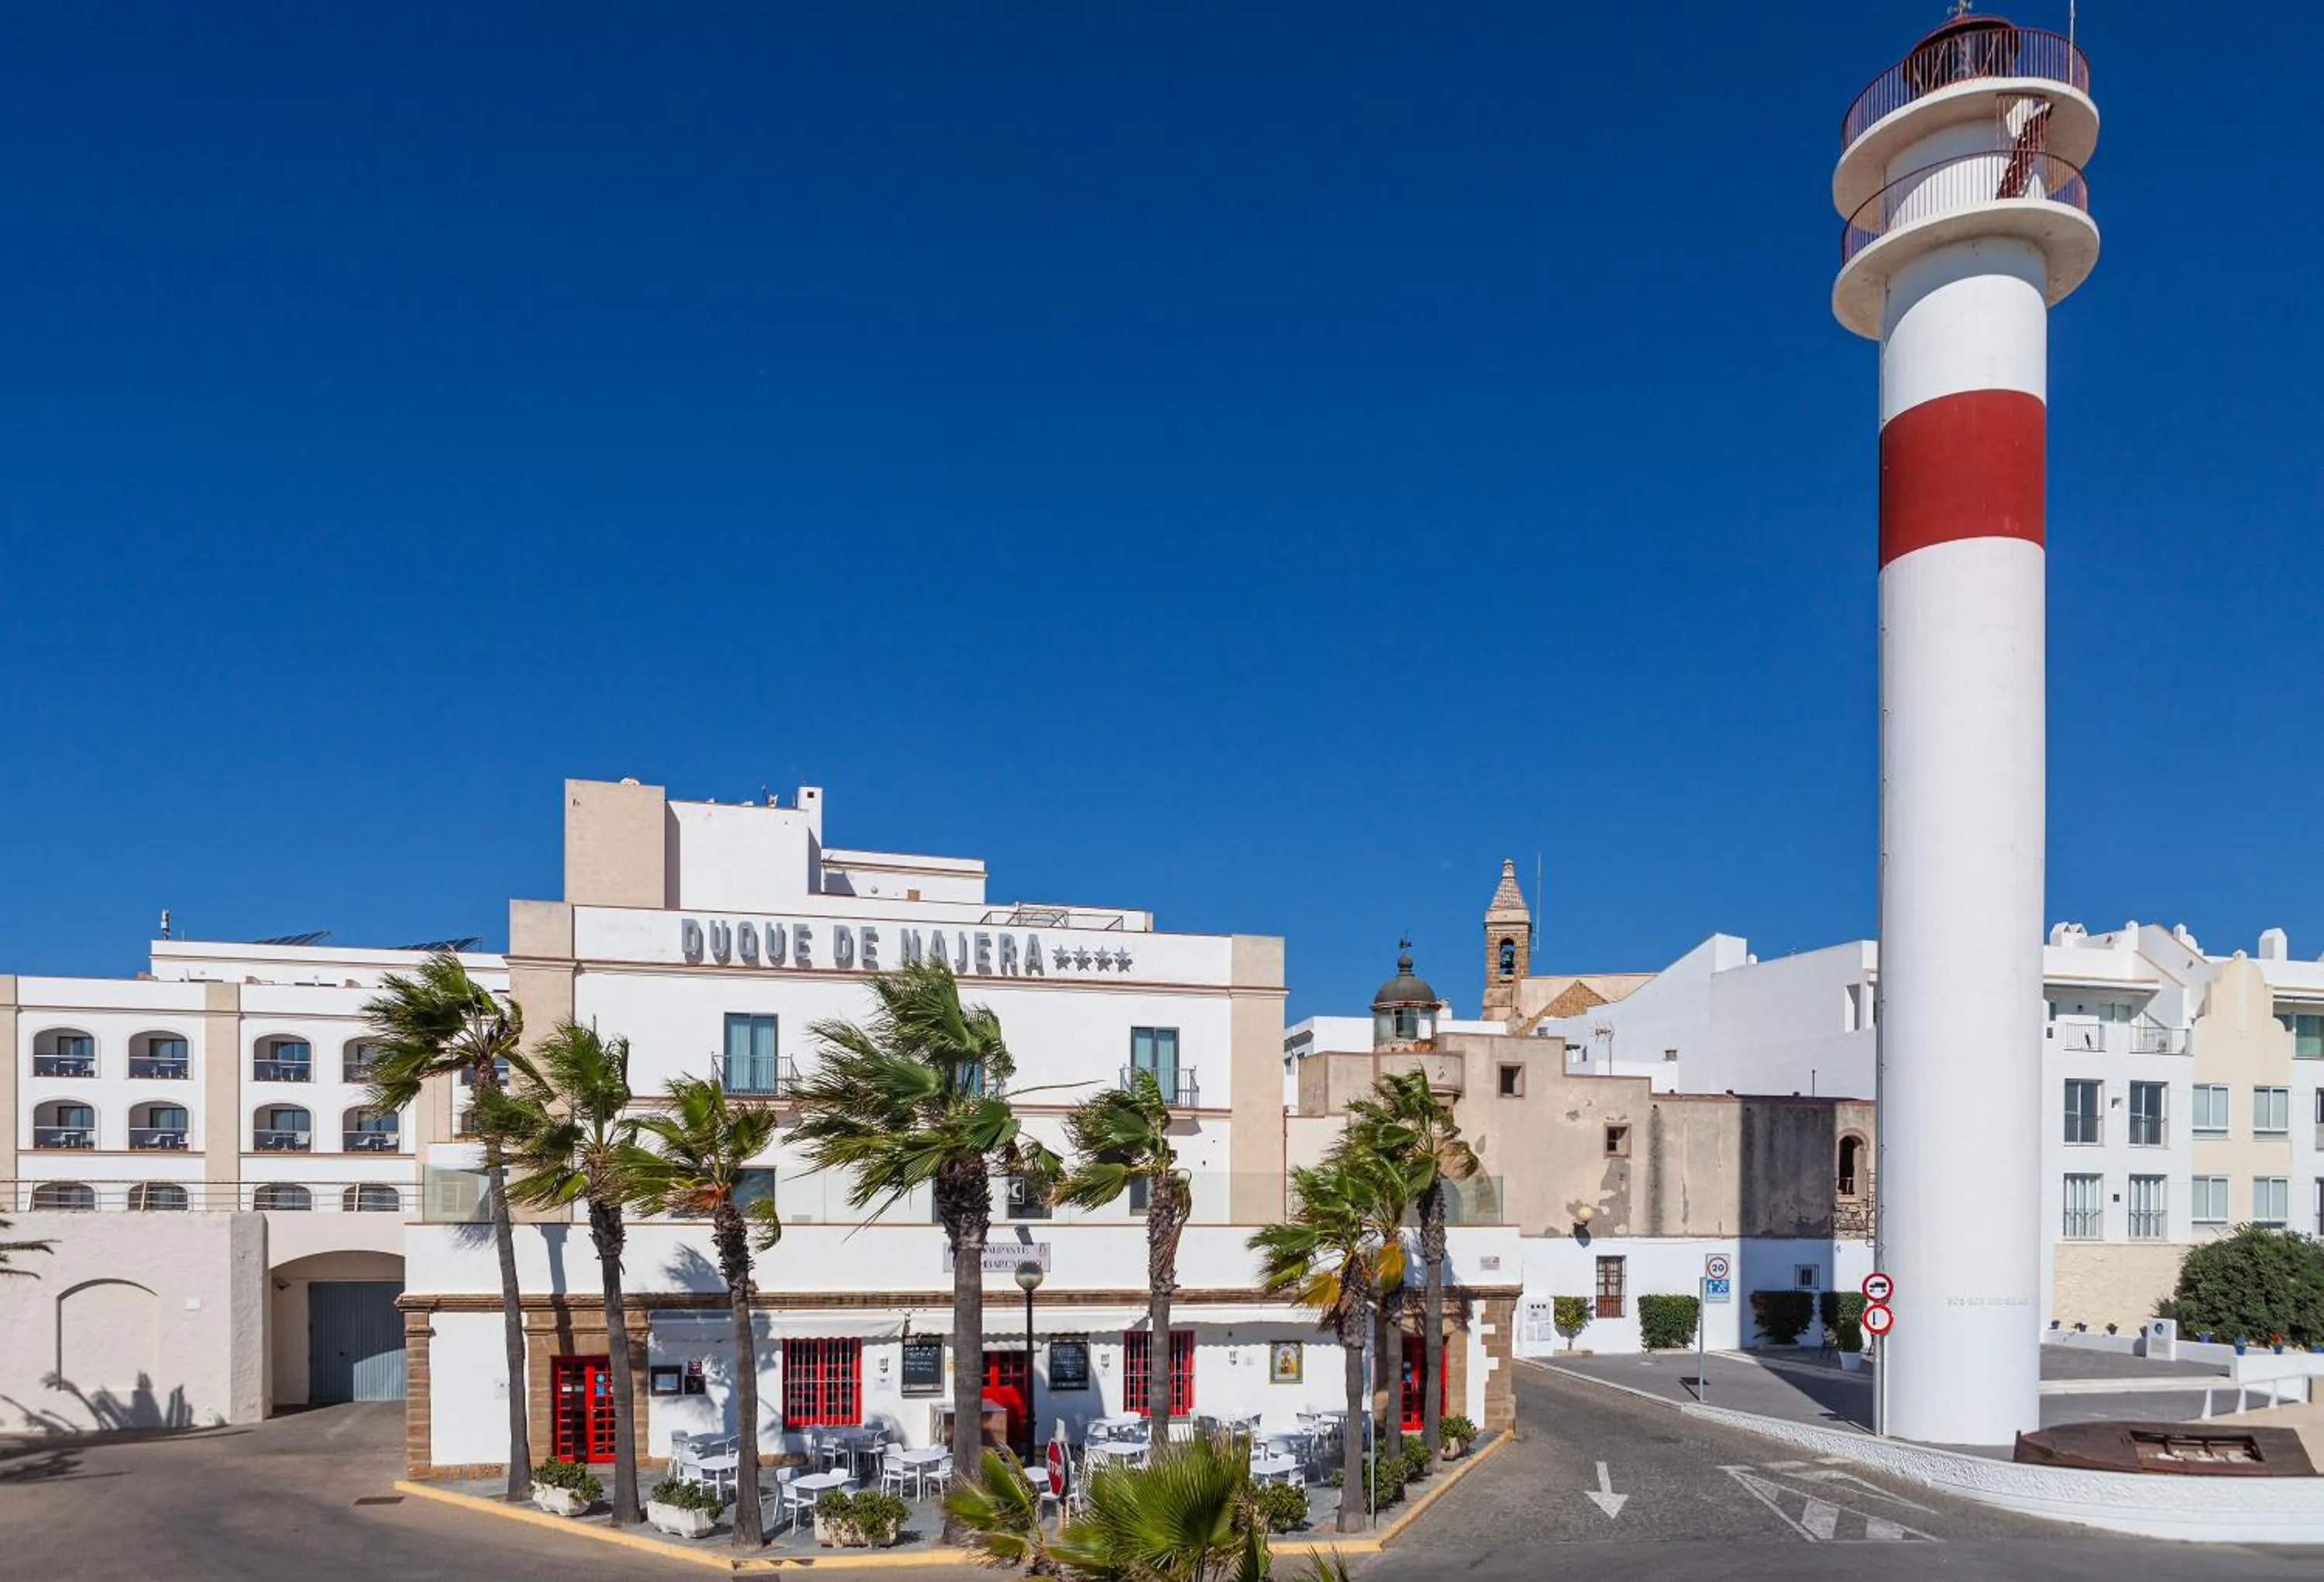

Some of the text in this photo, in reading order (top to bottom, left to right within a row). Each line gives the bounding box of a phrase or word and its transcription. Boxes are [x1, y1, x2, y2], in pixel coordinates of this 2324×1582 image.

[681, 918, 811, 965] DUQUE
[834, 925, 878, 967] DE
[1711, 1264, 1724, 1272] 20
